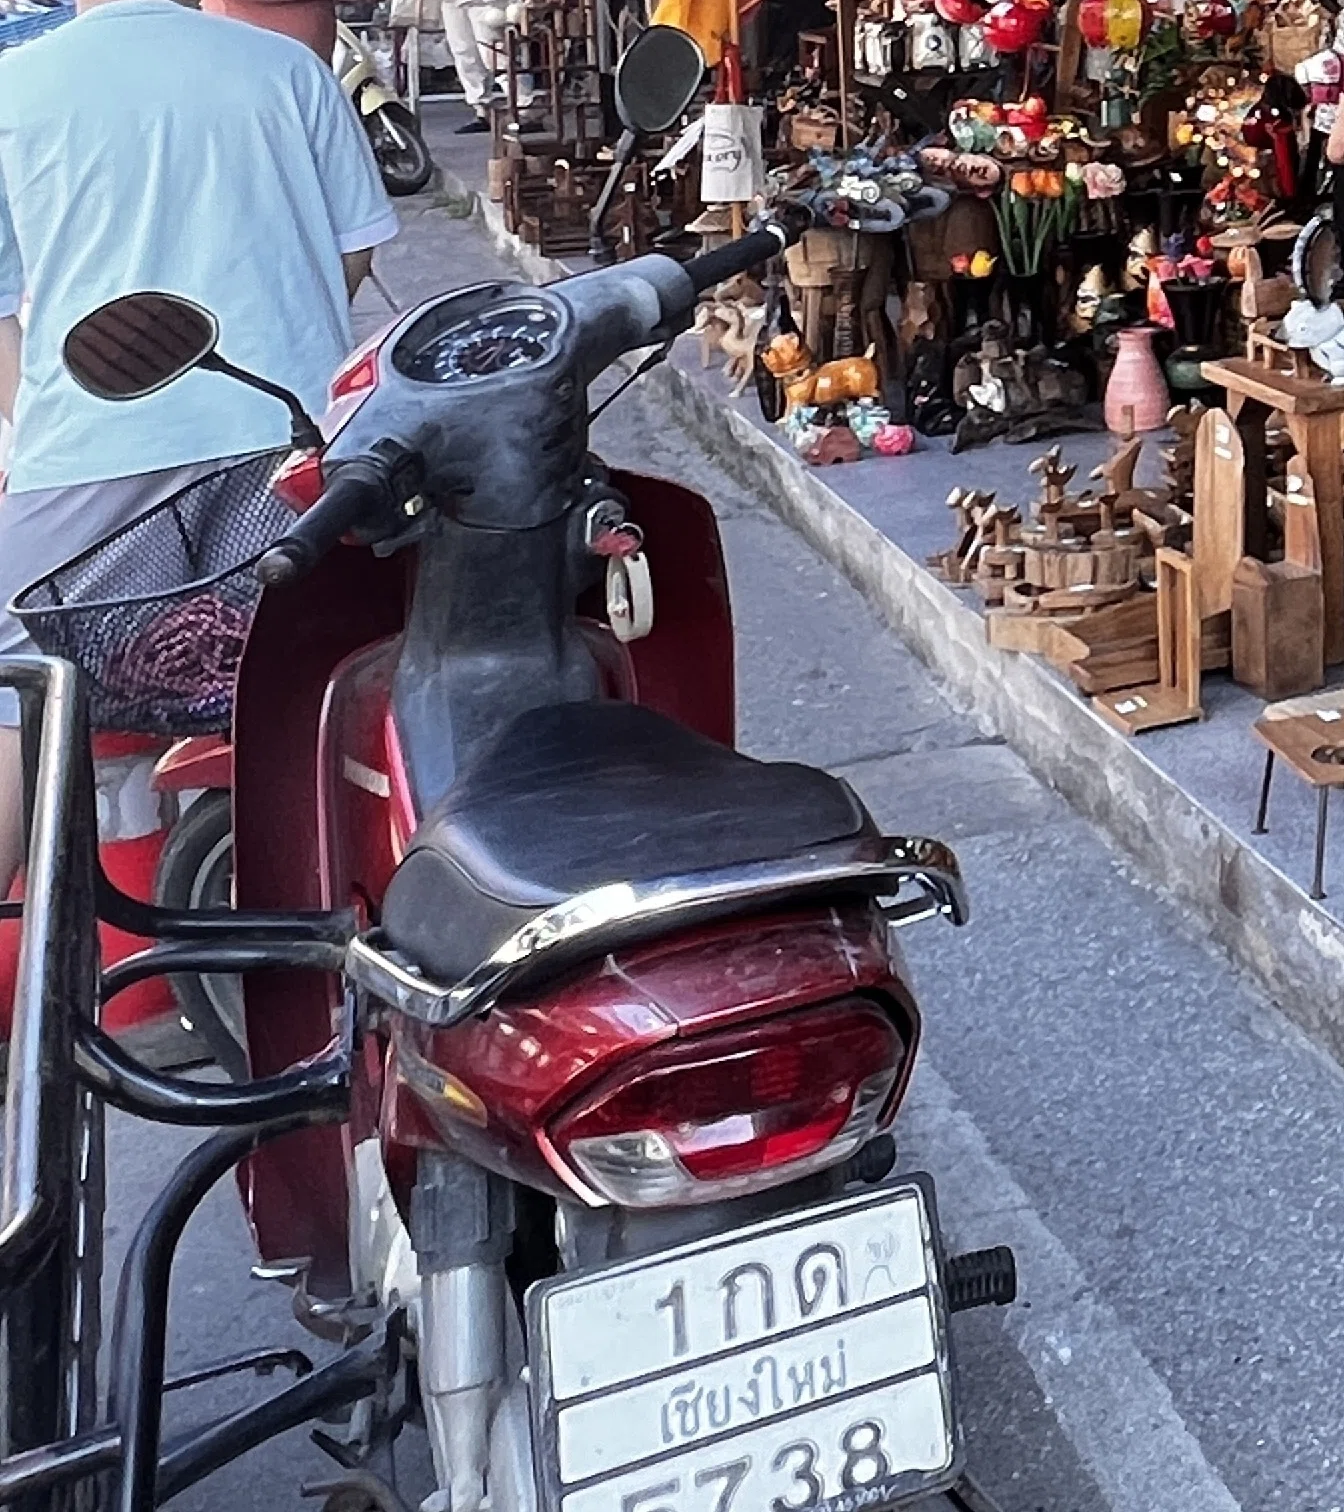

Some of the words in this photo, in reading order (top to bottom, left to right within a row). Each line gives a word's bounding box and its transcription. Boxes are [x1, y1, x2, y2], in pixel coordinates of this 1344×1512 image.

[655, 1241, 849, 1358] 1กด
[660, 1338, 847, 1444] เชียงใหม่
